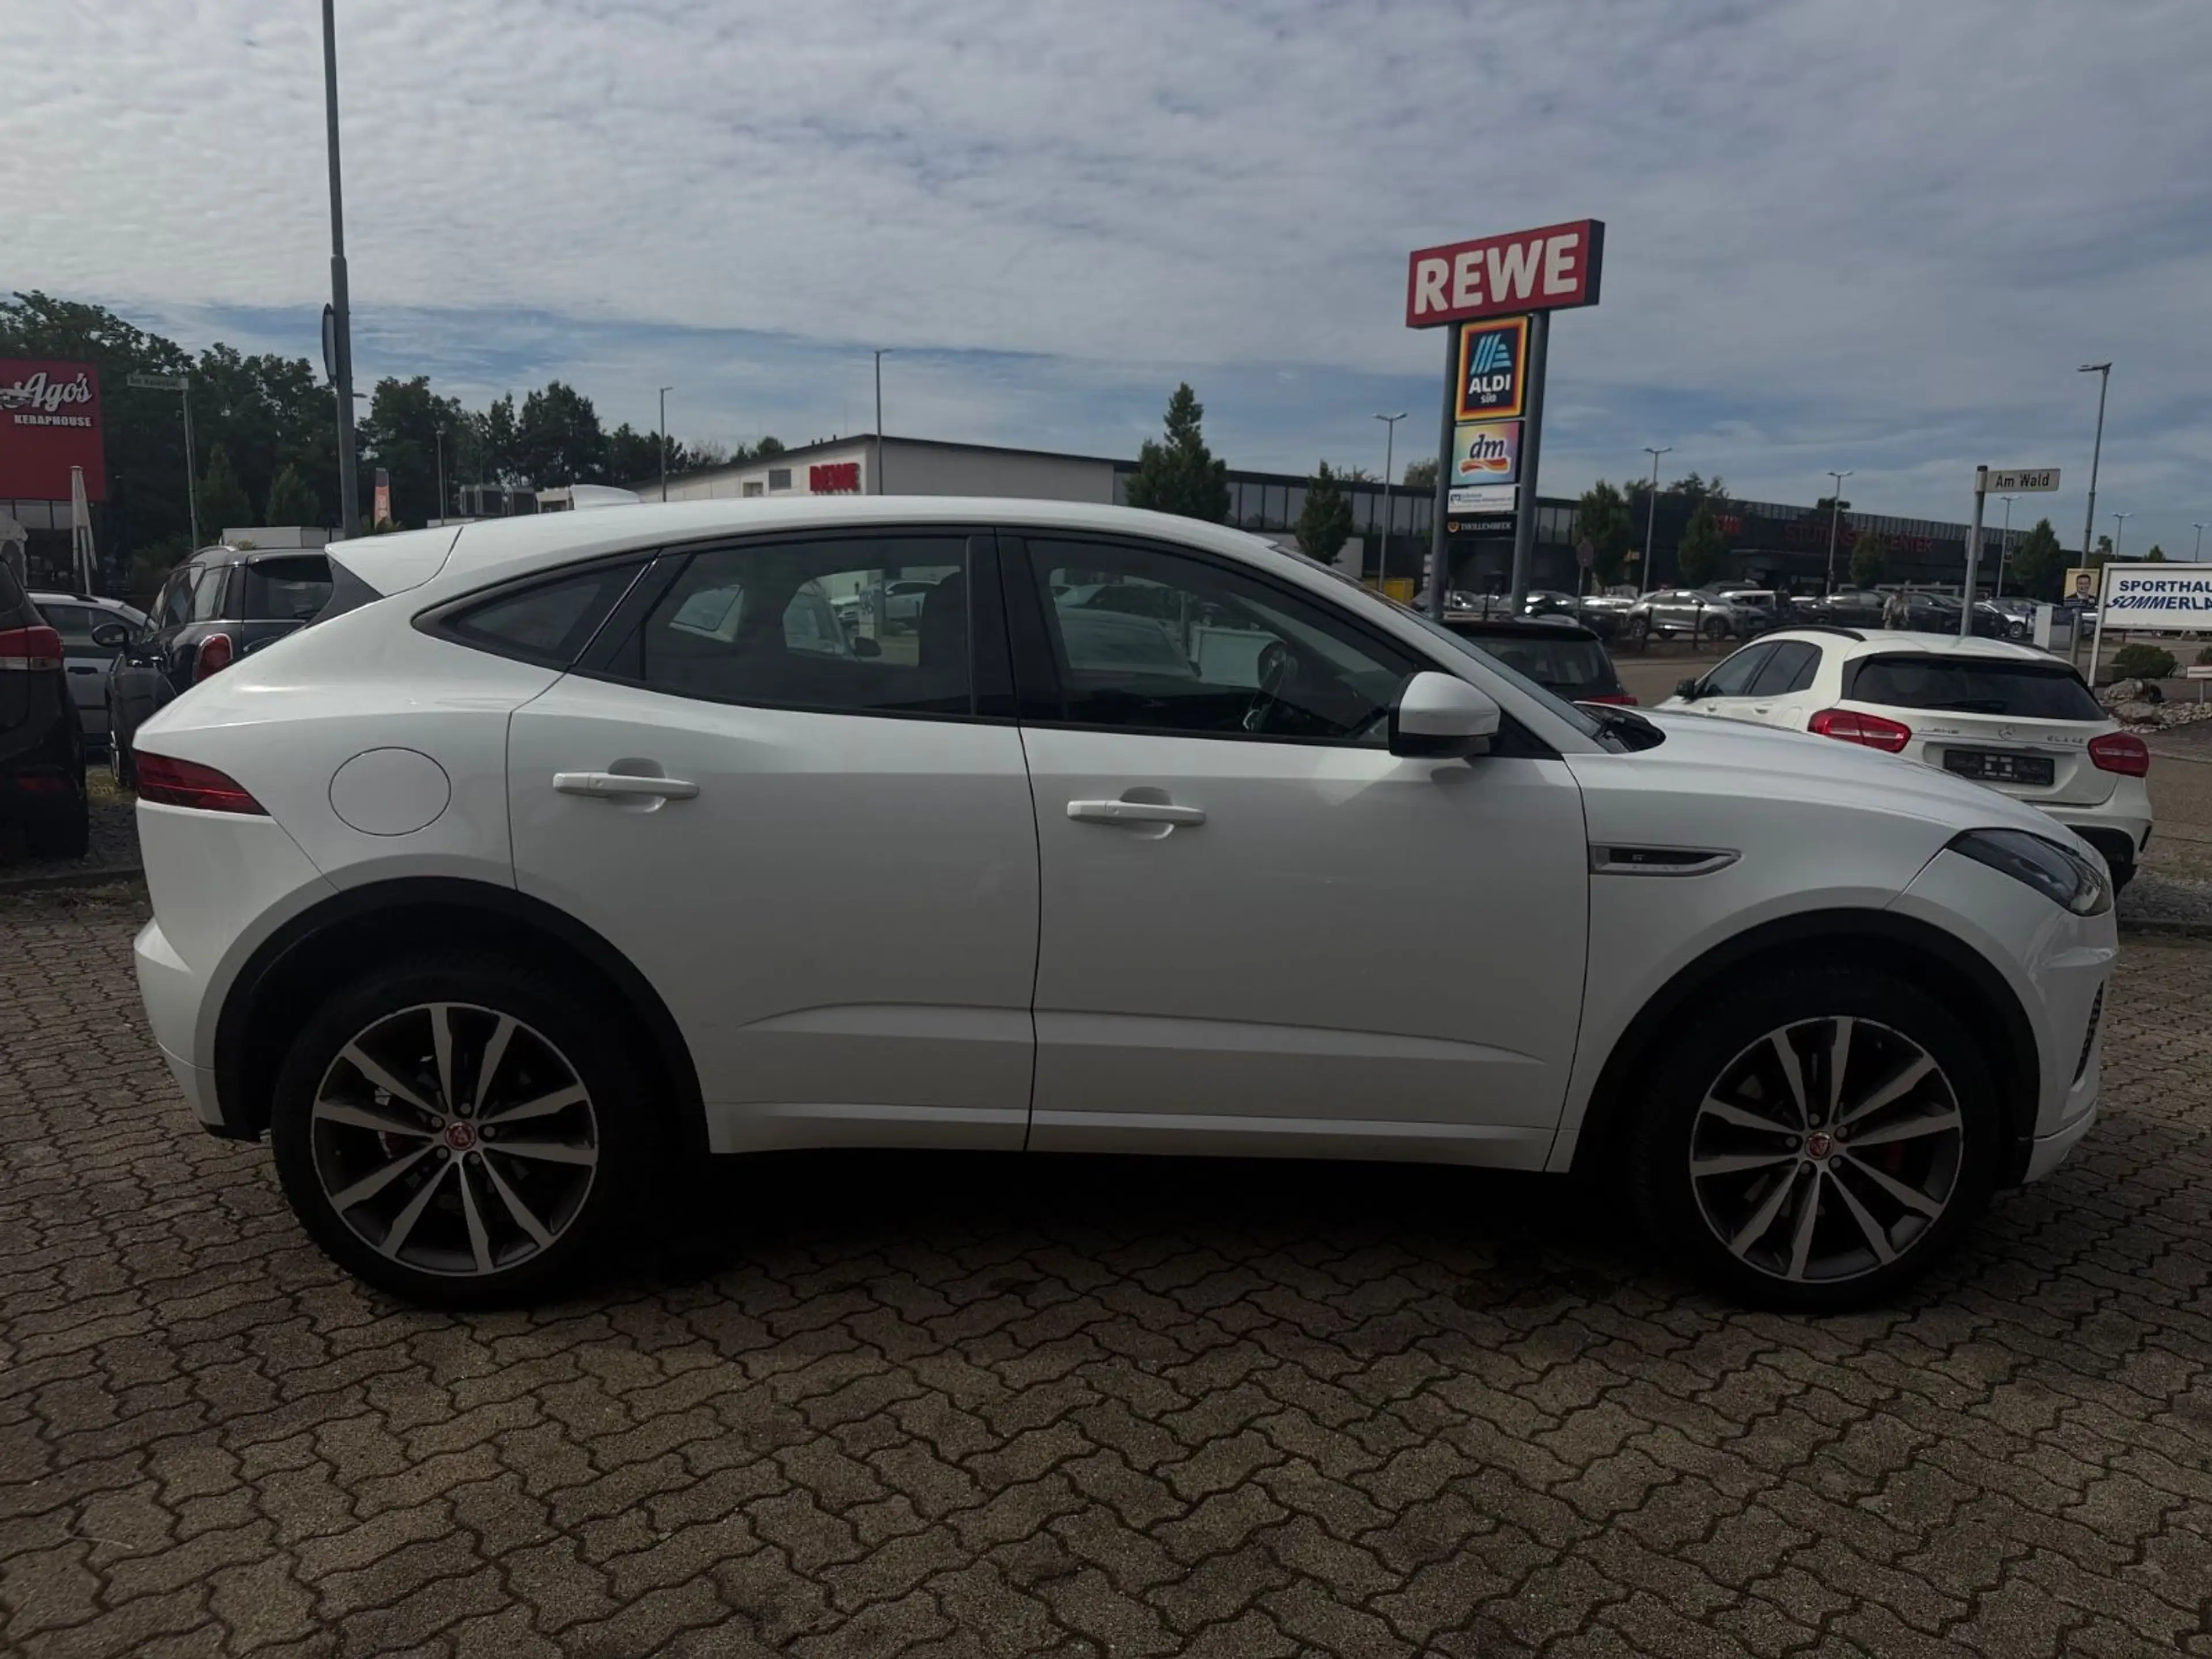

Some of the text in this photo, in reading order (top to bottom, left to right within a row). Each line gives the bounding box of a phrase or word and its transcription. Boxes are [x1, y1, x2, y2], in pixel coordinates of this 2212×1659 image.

[1414, 233, 1580, 315] REWE
[14, 372, 93, 412] Ago's
[1468, 374, 1512, 394] ALDI
[13, 414, 92, 427] KEBAPHOUSE
[1469, 434, 1505, 459] dm
[1995, 472, 2050, 488] Am Wald
[2119, 580, 2212, 593] SPORTHAU
